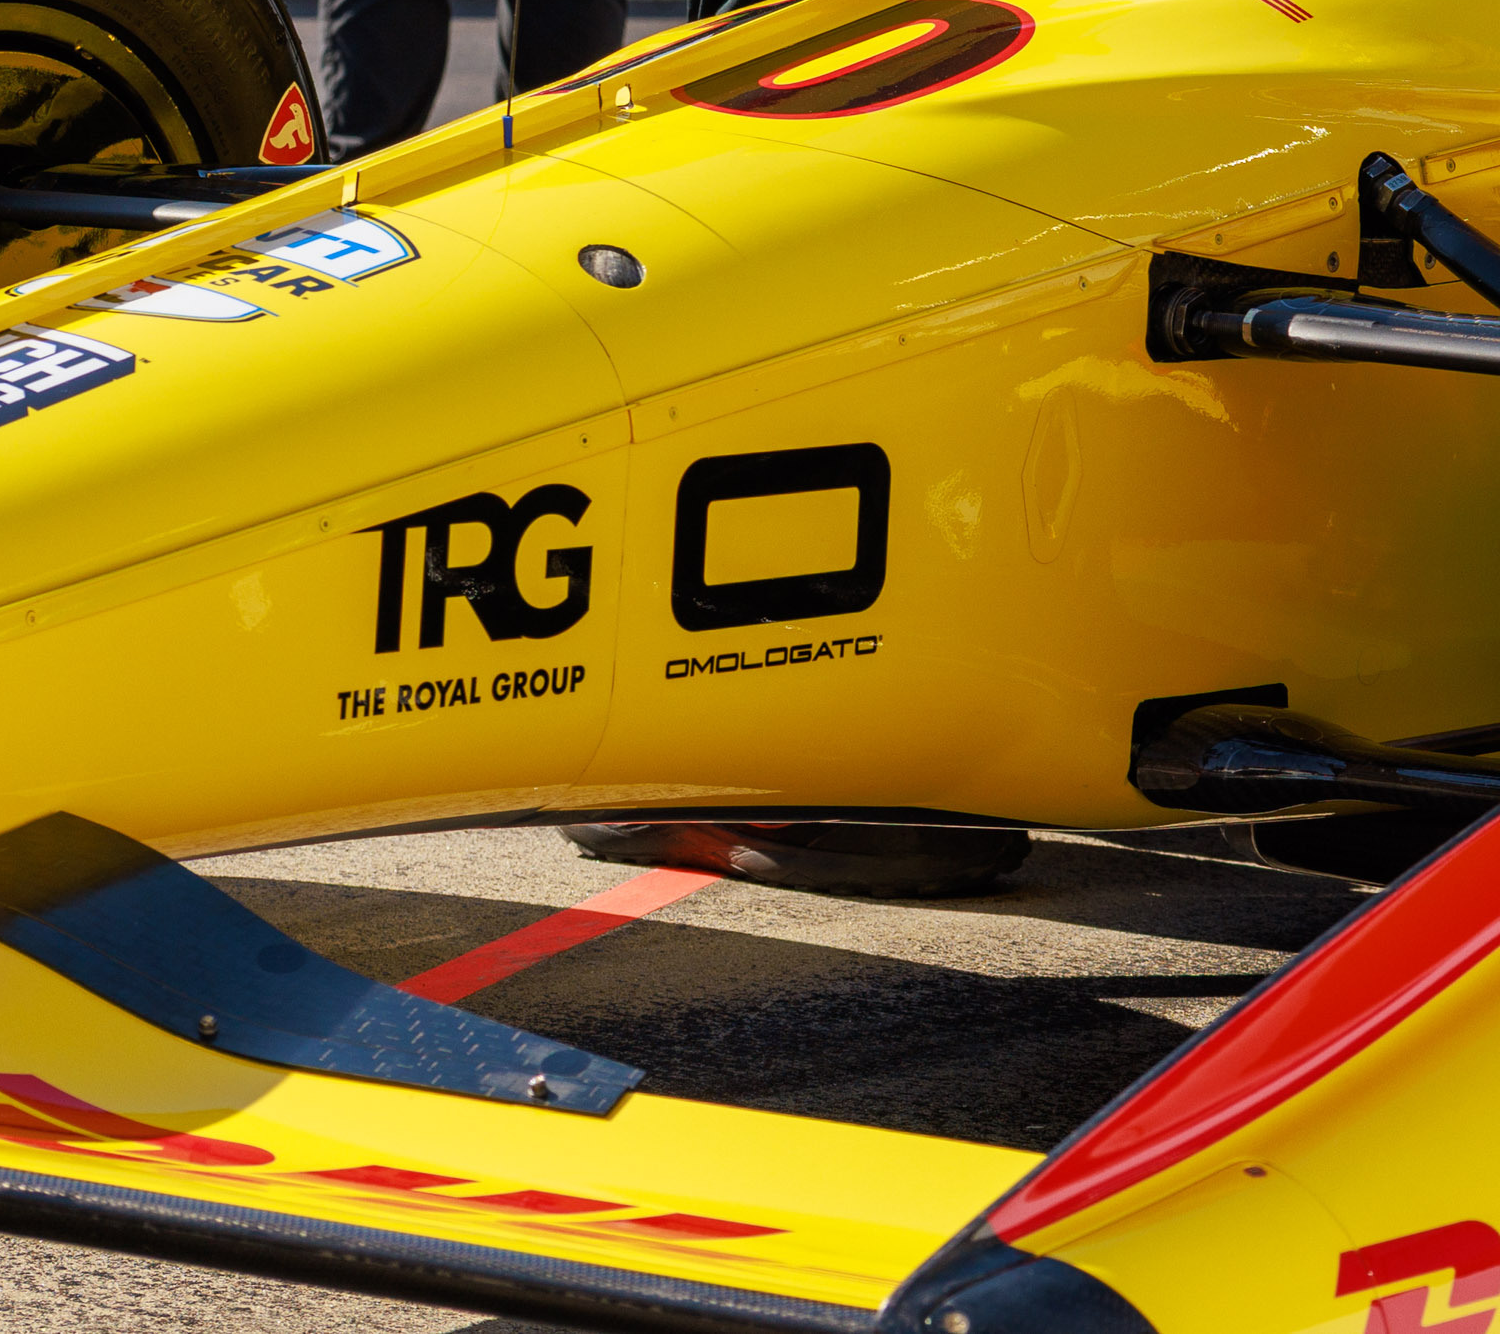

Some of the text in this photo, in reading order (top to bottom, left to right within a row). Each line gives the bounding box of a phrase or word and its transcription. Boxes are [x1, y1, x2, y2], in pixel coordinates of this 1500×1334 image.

[665, 634, 884, 680] OMOLOGATO
[337, 664, 587, 721] THE ROYAL GROUP
